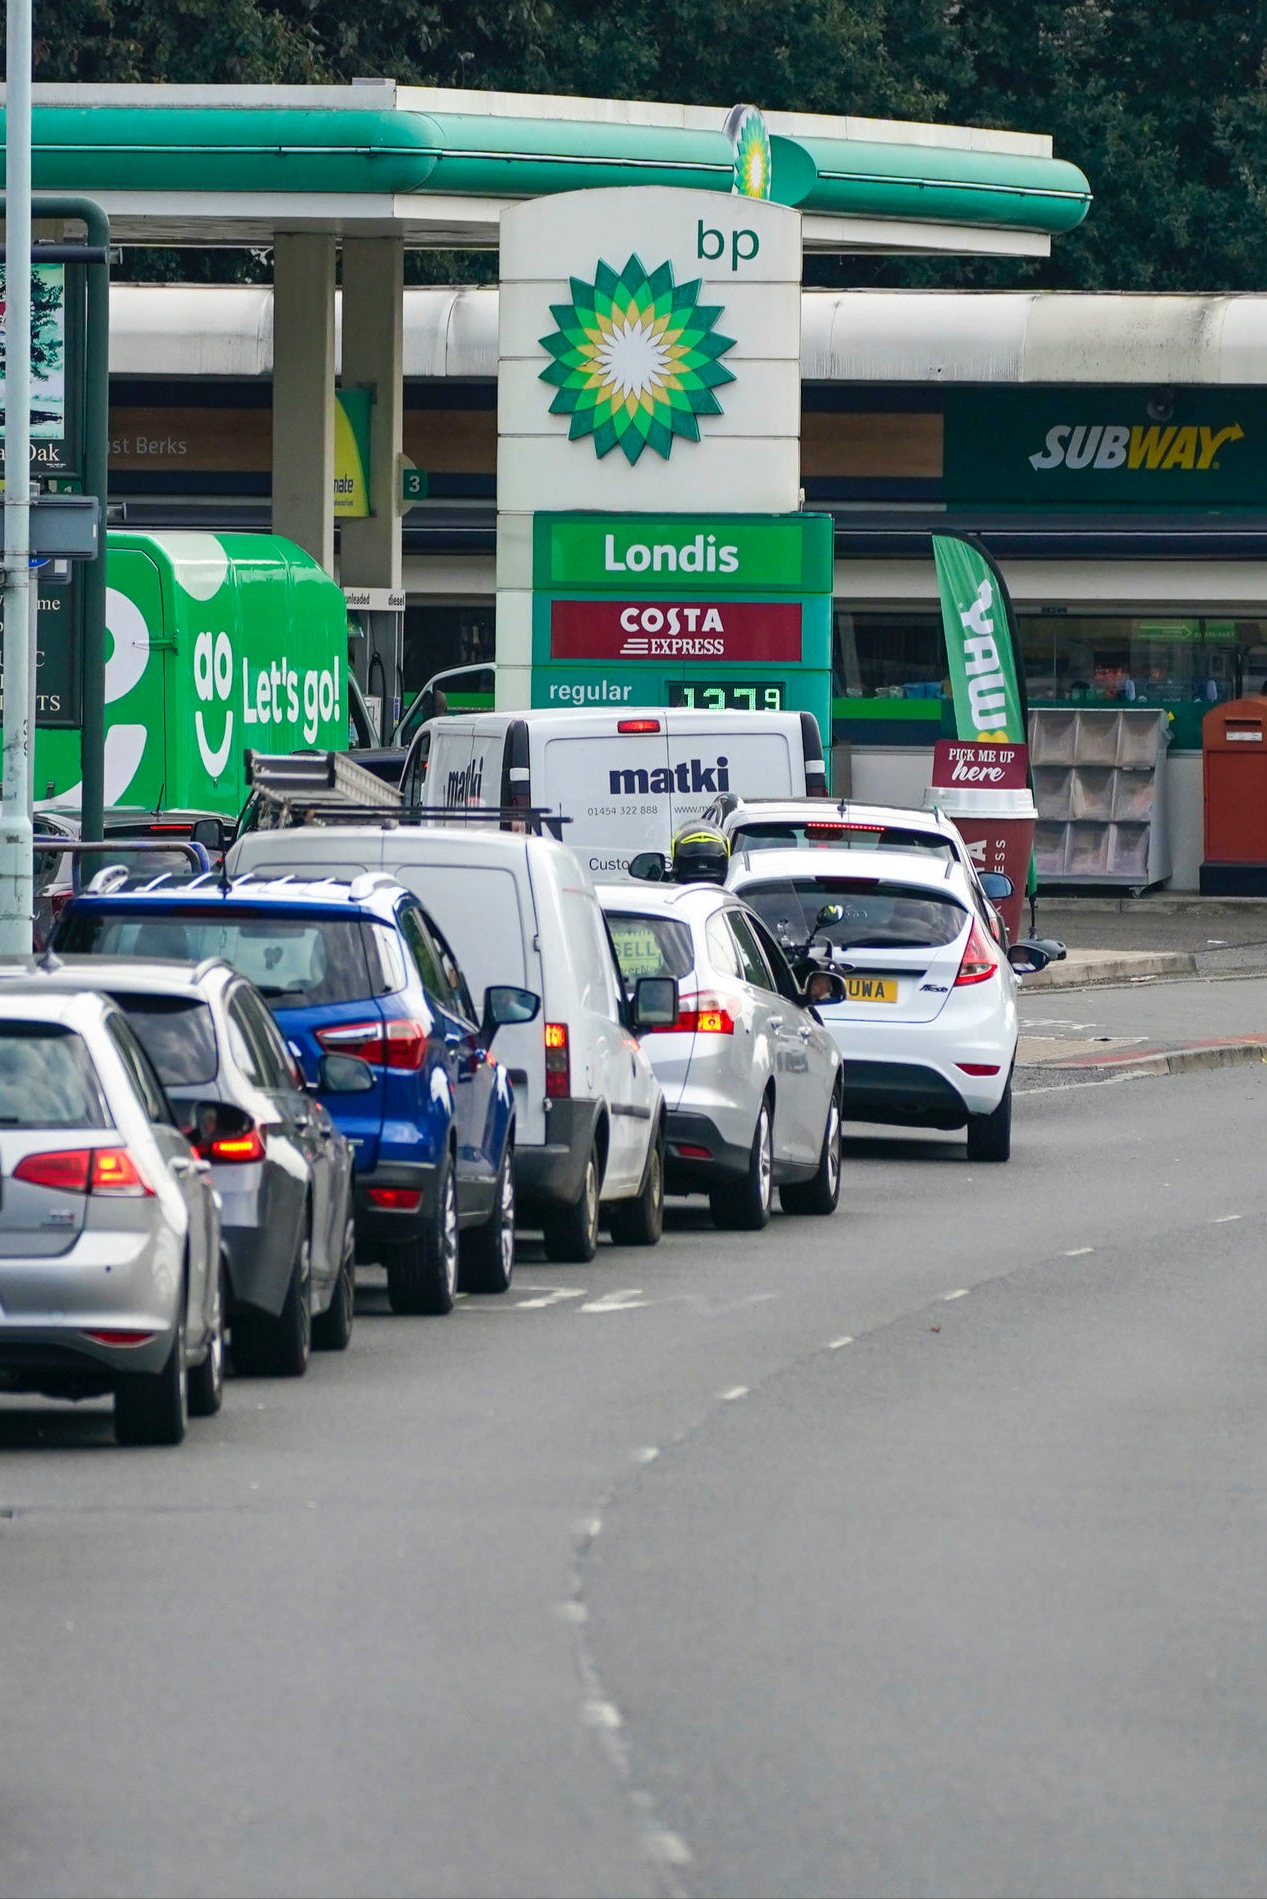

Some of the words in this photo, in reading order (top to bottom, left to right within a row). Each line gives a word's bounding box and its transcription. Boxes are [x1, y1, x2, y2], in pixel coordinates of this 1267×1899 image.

[697, 219, 760, 272] bp
[136, 437, 188, 455] Berks
[1029, 423, 1245, 471] SUBWAY
[408, 475, 421, 493] 3
[605, 534, 739, 573] Londis
[620, 607, 725, 636] COSTA
[650, 638, 725, 655] EXPRESS
[960, 578, 1009, 743] WAY
[243, 656, 300, 724] Let's
[303, 655, 341, 745] go!
[549, 680, 633, 705] regular
[948, 748, 975, 762] PICK
[978, 750, 996, 763] ME
[999, 751, 1015, 764] UP
[609, 756, 730, 795] matki
[951, 759, 1005, 782] here
[620, 806, 636, 815] 322
[640, 805, 659, 815] 888
[589, 857, 630, 872] Custo
[848, 980, 886, 999] UWA
